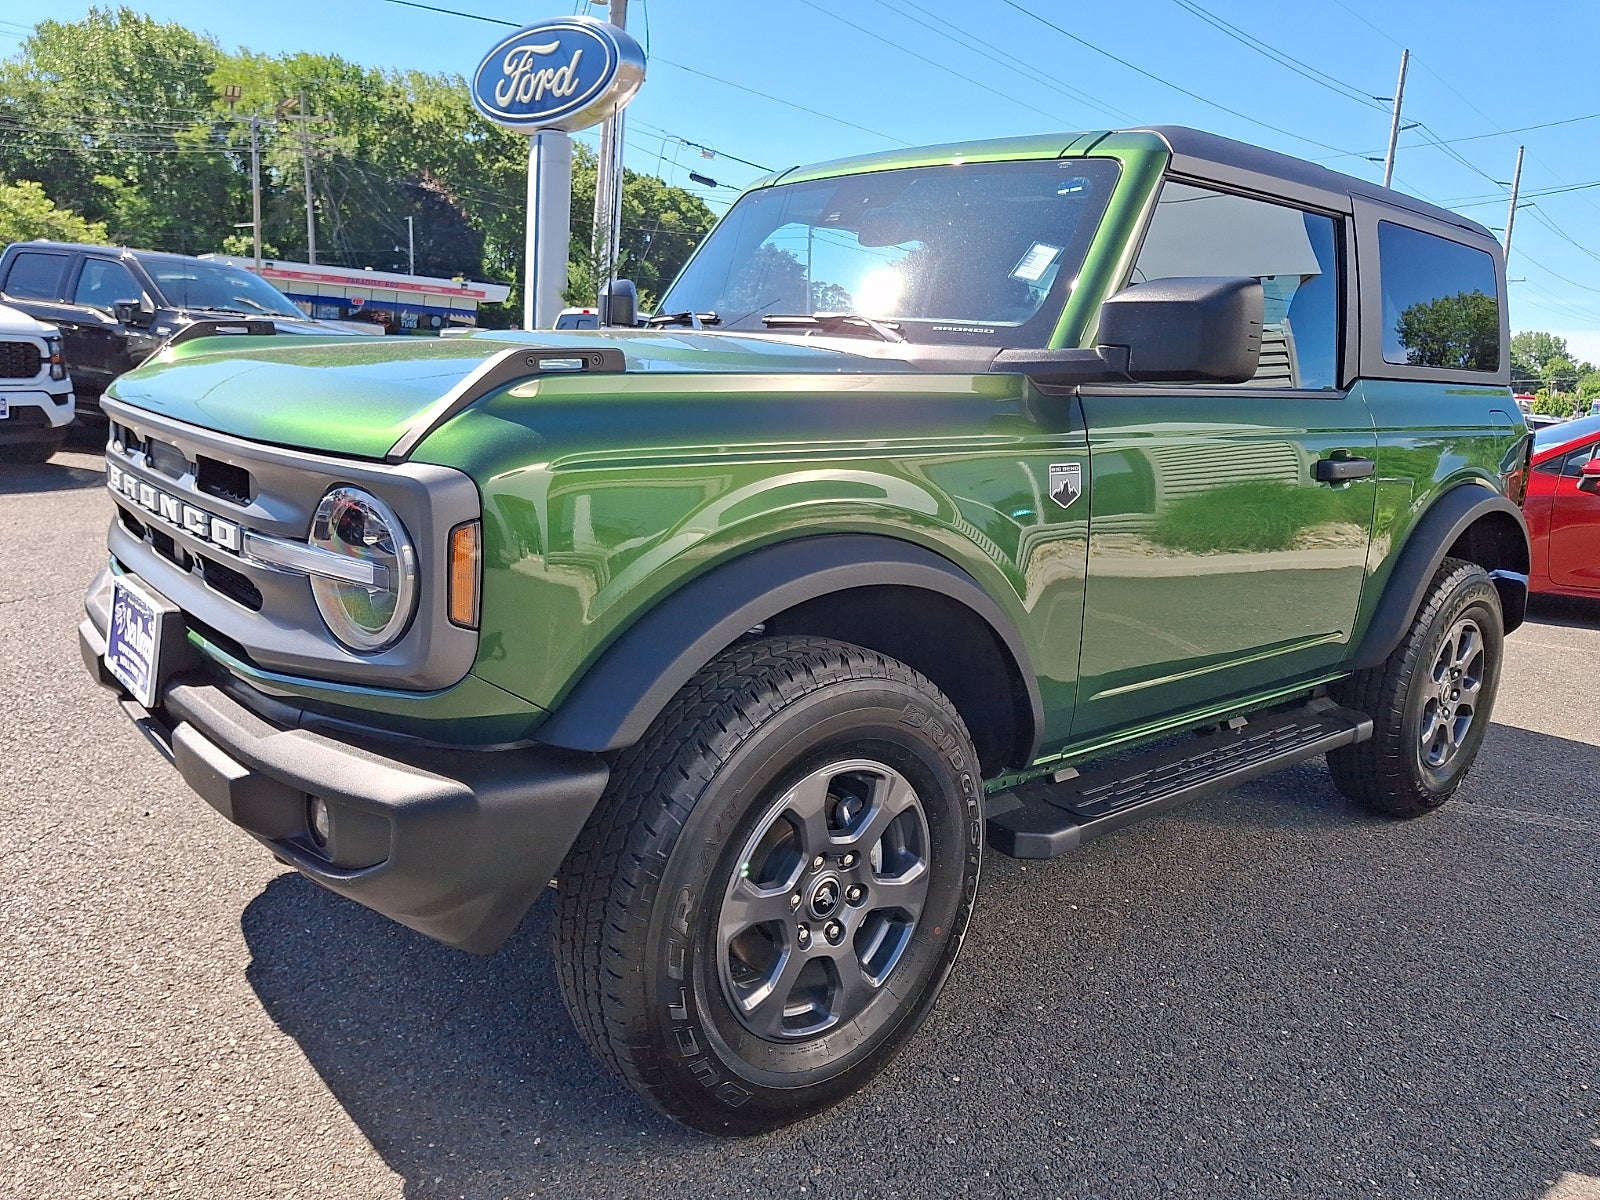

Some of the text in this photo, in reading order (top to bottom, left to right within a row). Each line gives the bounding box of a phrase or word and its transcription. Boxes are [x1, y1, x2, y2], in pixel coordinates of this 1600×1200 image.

[495, 40, 583, 107] Ford
[932, 326, 995, 334] BRONCO
[109, 463, 240, 552] BRONCO
